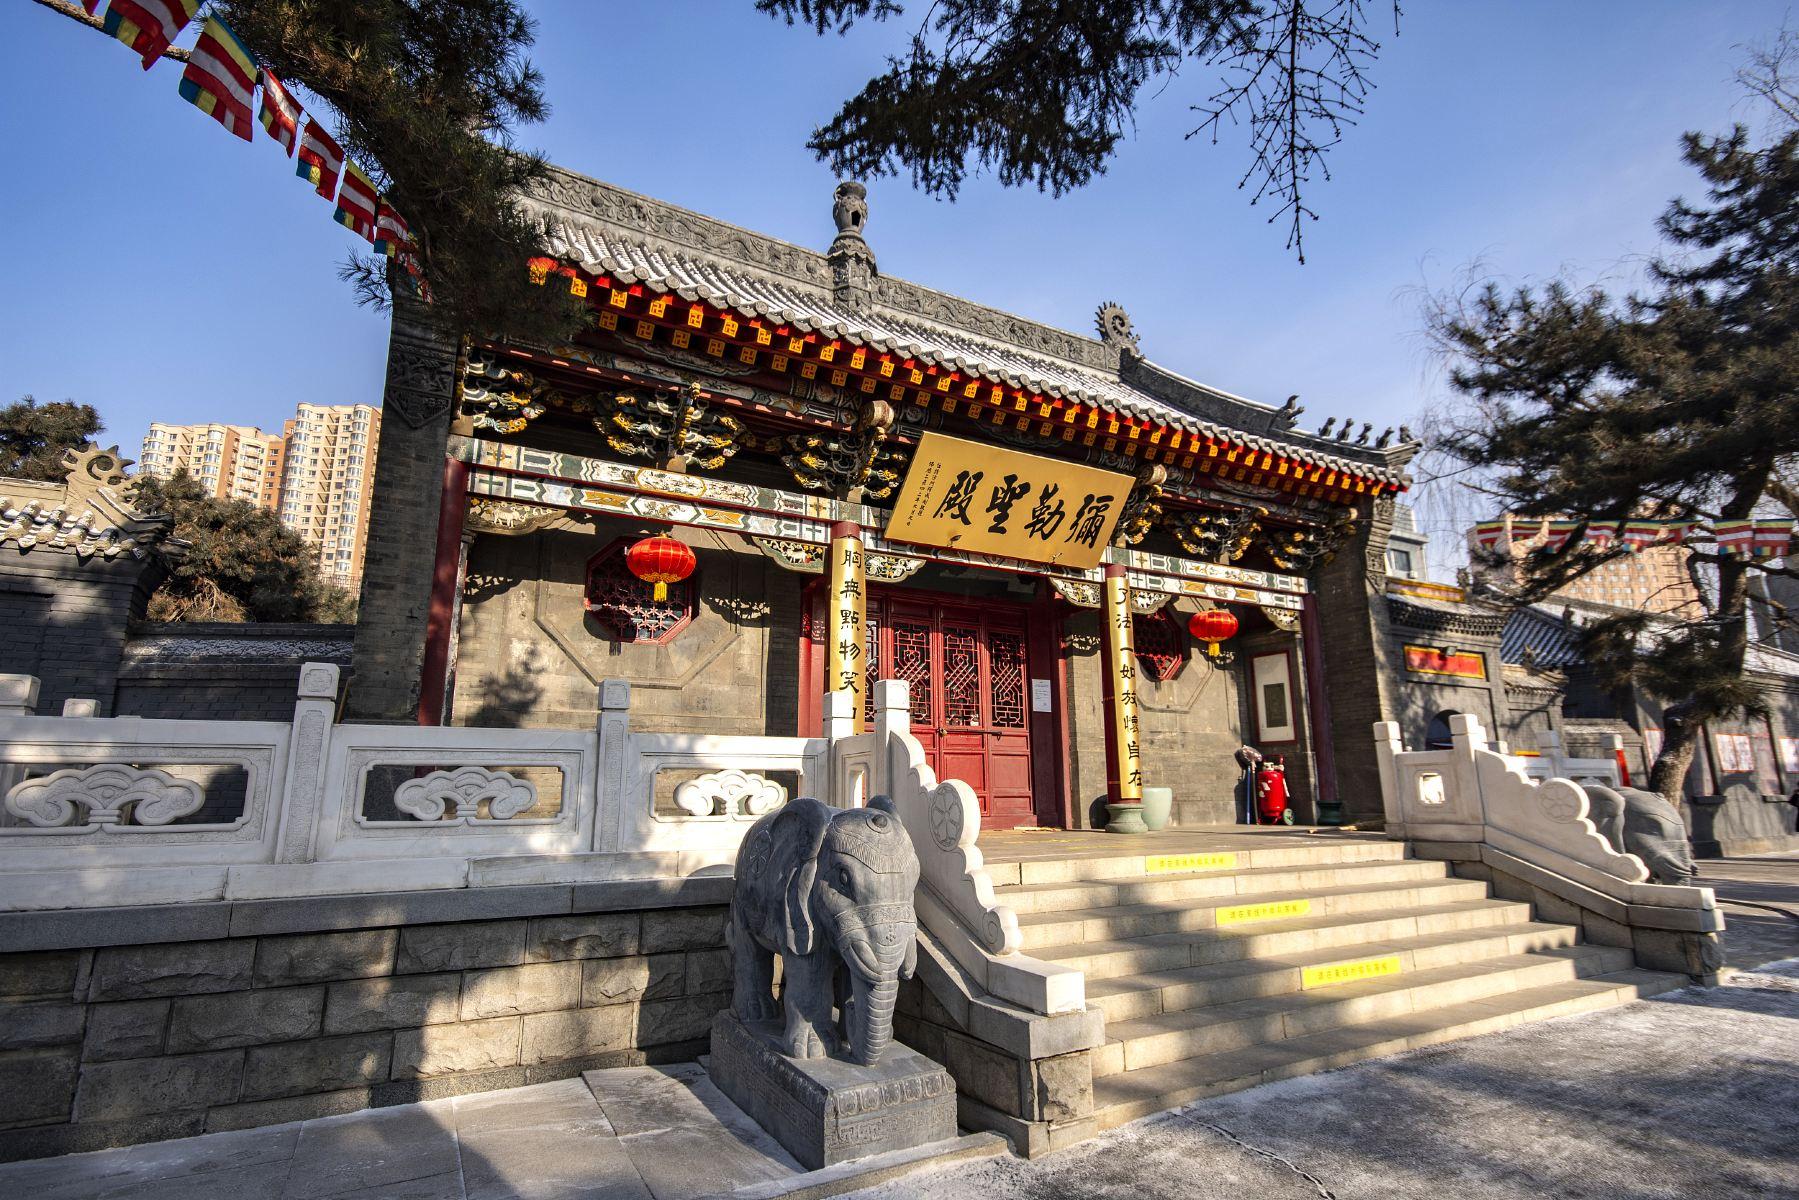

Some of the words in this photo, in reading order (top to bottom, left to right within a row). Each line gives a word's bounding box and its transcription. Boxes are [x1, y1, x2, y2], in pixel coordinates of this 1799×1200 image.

[839, 549, 863, 720] 胸無點物笑
